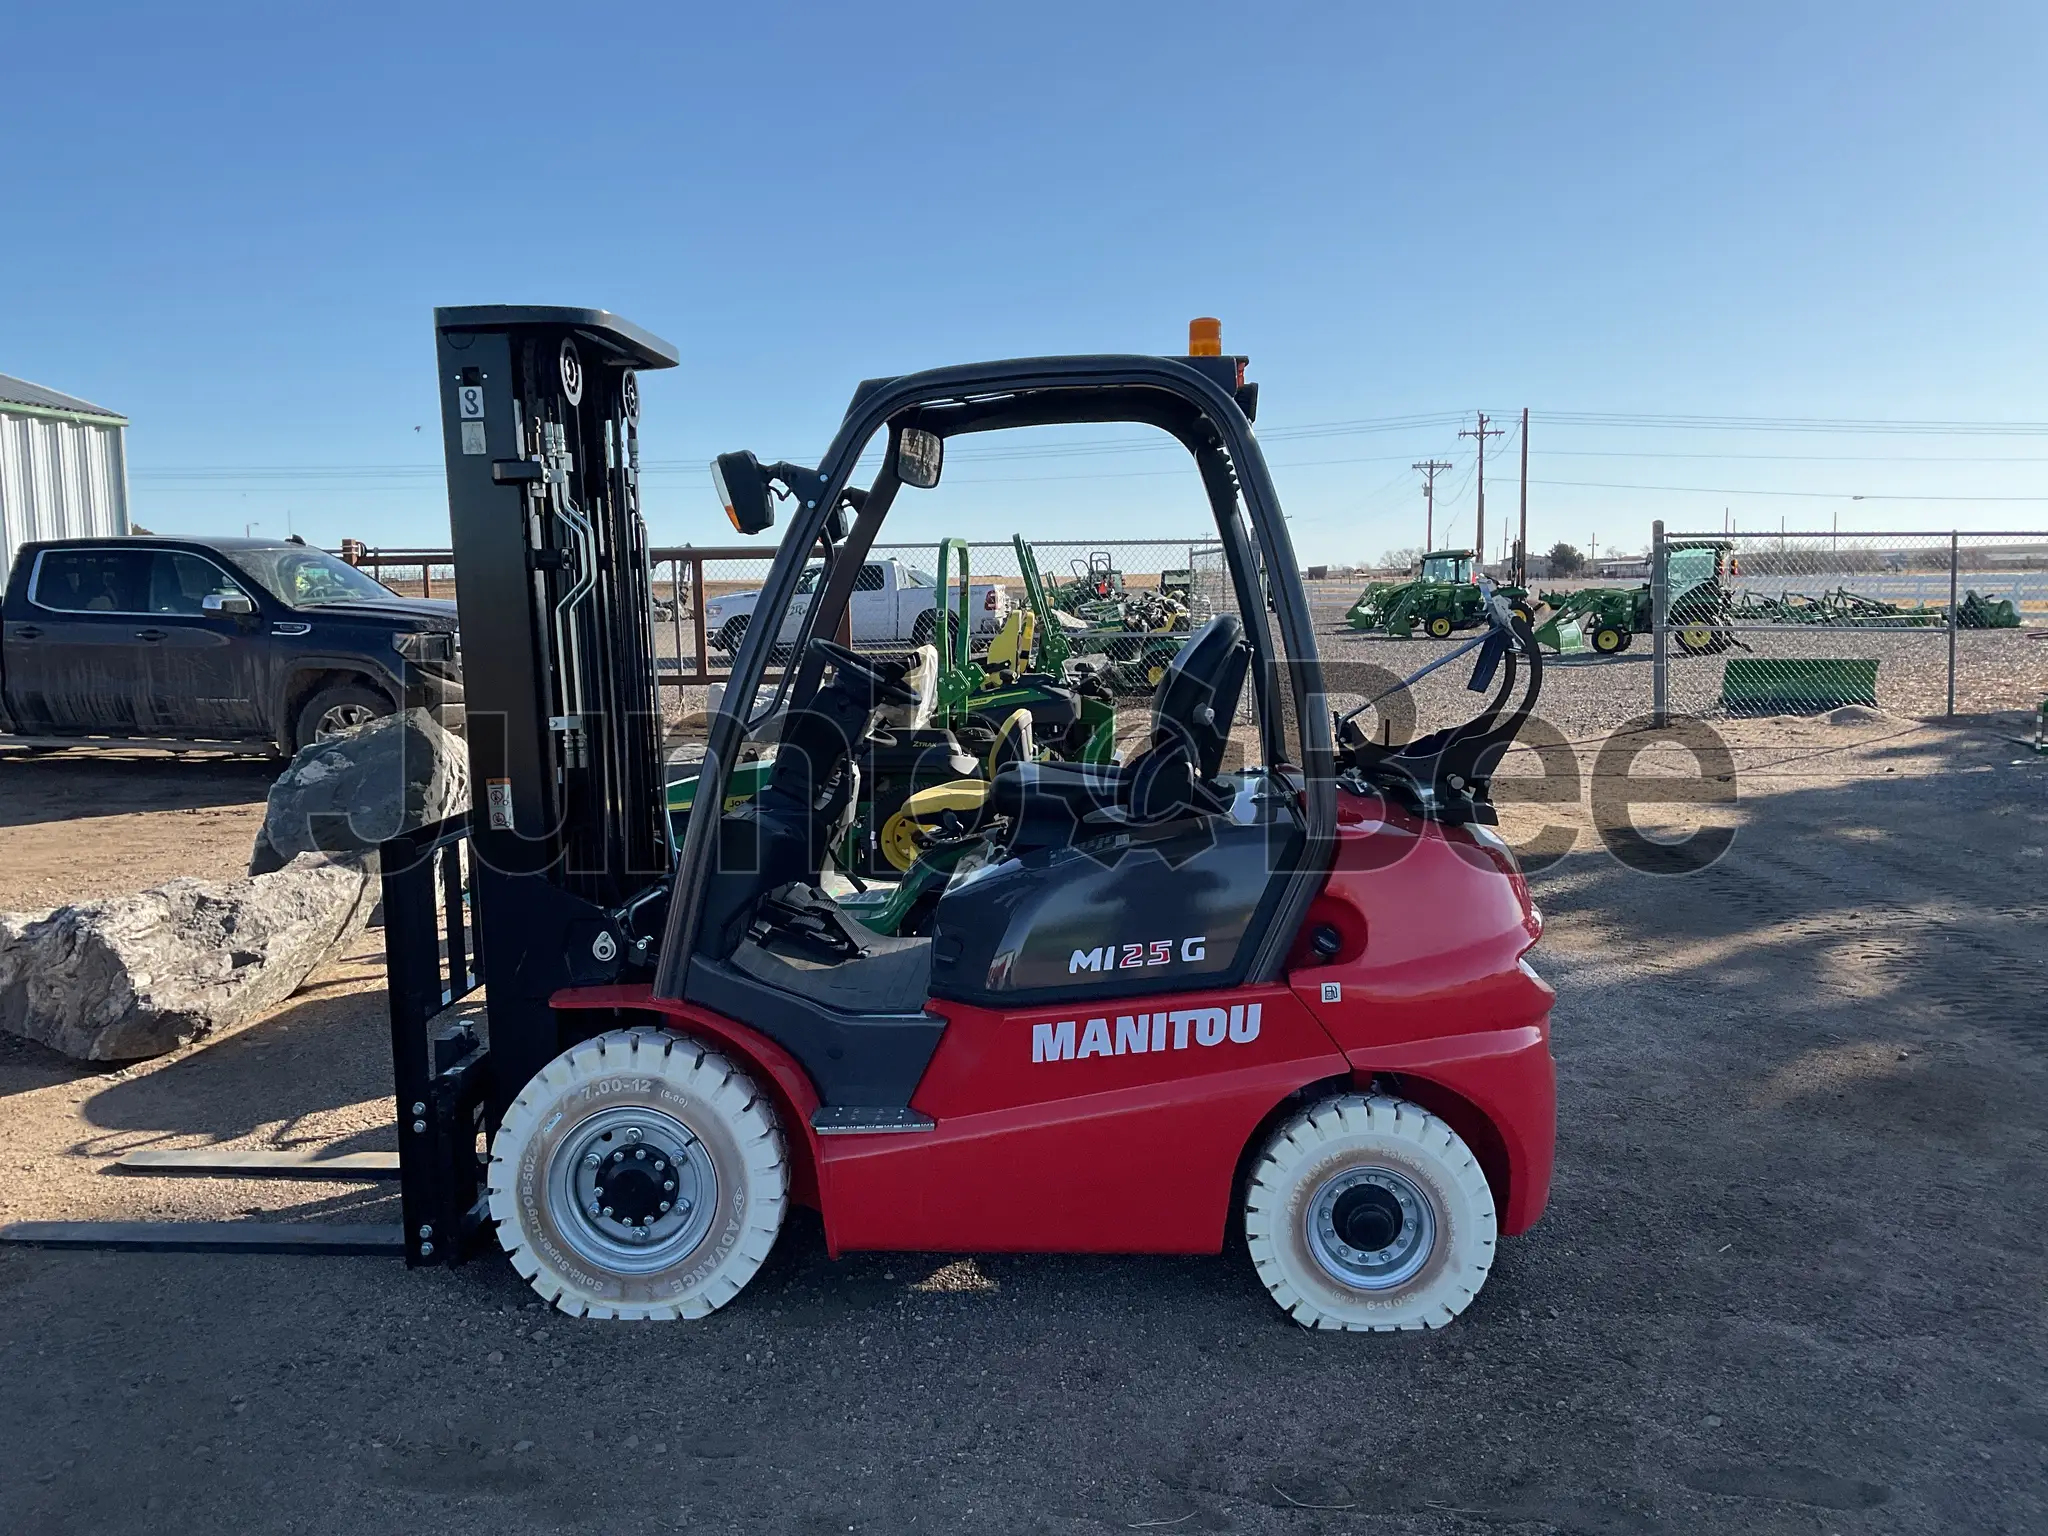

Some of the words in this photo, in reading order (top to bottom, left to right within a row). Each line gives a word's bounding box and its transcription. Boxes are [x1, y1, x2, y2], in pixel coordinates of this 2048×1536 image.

[1032, 1003, 1263, 1063] MANITOU
[581, 1078, 652, 1101] 7.00-12
[1289, 1150, 1343, 1215] ADVANCE
[670, 1217, 740, 1293] ADVANCE
